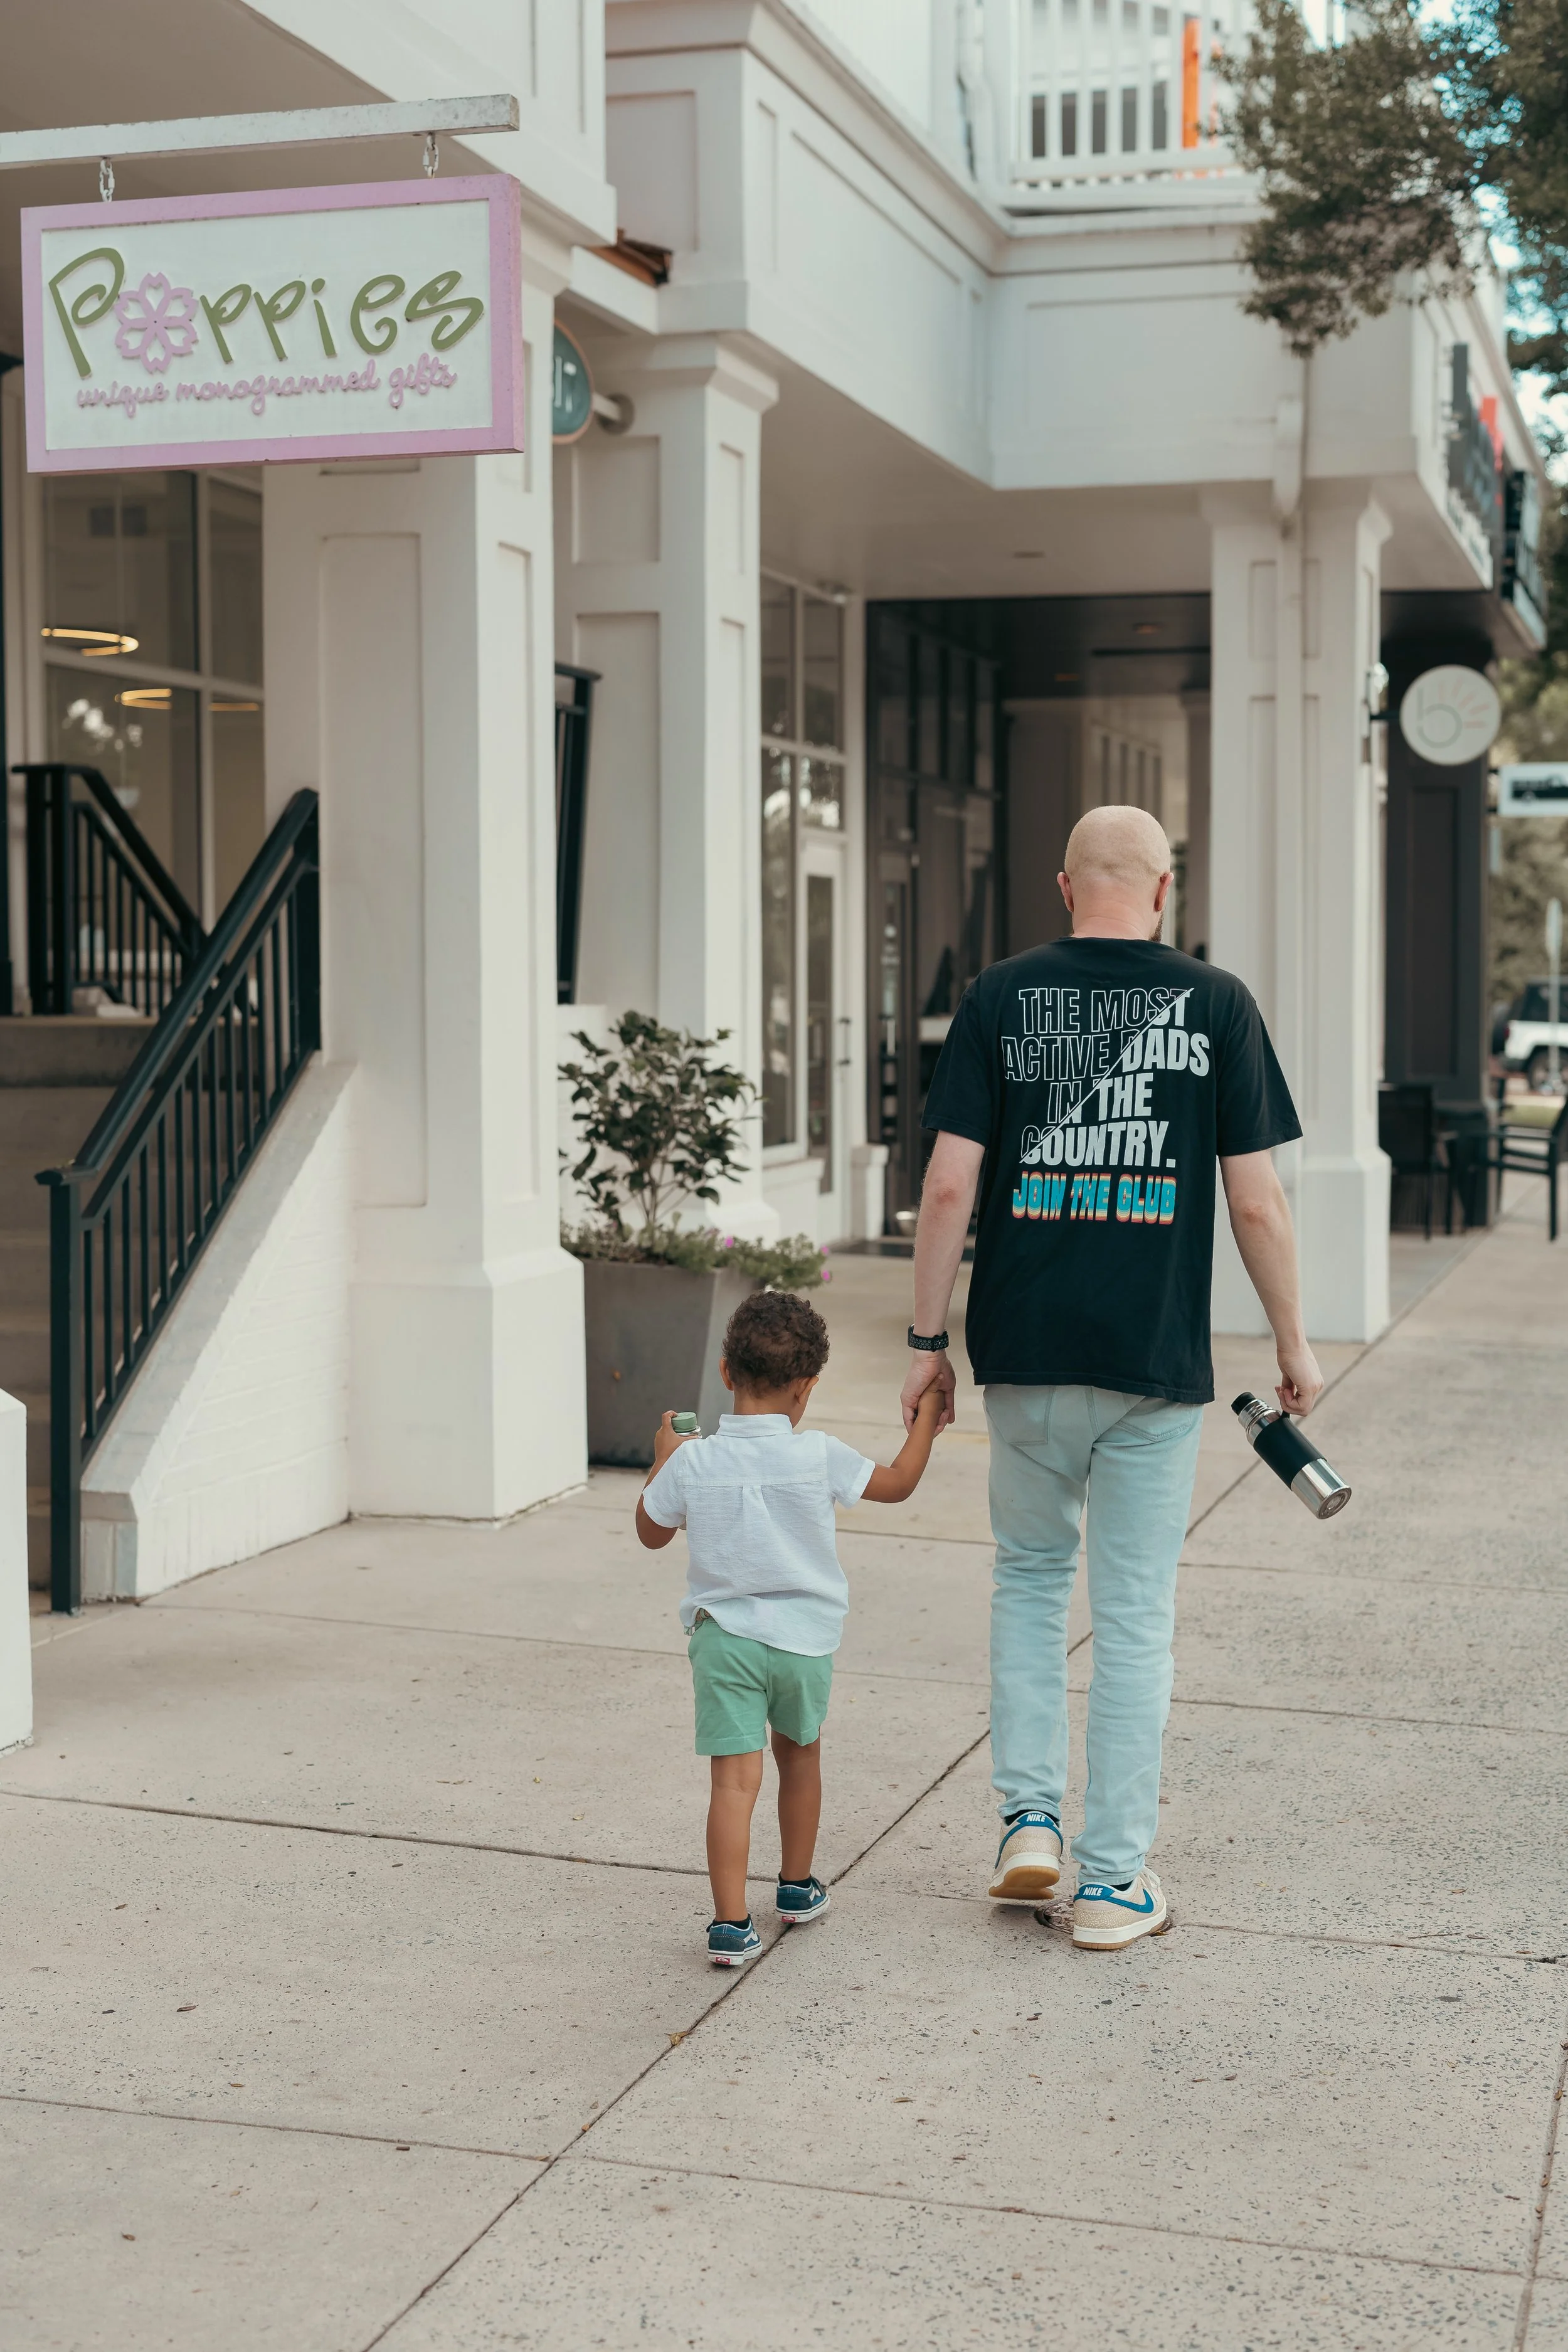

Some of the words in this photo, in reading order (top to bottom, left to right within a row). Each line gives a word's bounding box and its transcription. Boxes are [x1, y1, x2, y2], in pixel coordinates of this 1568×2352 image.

[77, 380, 169, 418] unique
[176, 359, 381, 415] monogrammed
[388, 352, 458, 408] gifts
[1019, 988, 1080, 1034] THE
[1091, 987, 1191, 1032] MOST
[1002, 1034, 1110, 1081] ACTIVE
[1120, 1029, 1210, 1077] DADS
[1047, 1081, 1082, 1124] IN
[1093, 1073, 1153, 1121] THE
[1020, 1121, 1176, 1168] COUNTRY.
[1012, 1170, 1066, 1221] JOIN
[1070, 1172, 1111, 1221] THE
[1116, 1173, 1177, 1225] CLUB
[1027, 1814, 1046, 1822] NIKE
[1083, 1888, 1103, 1896] NIKE
